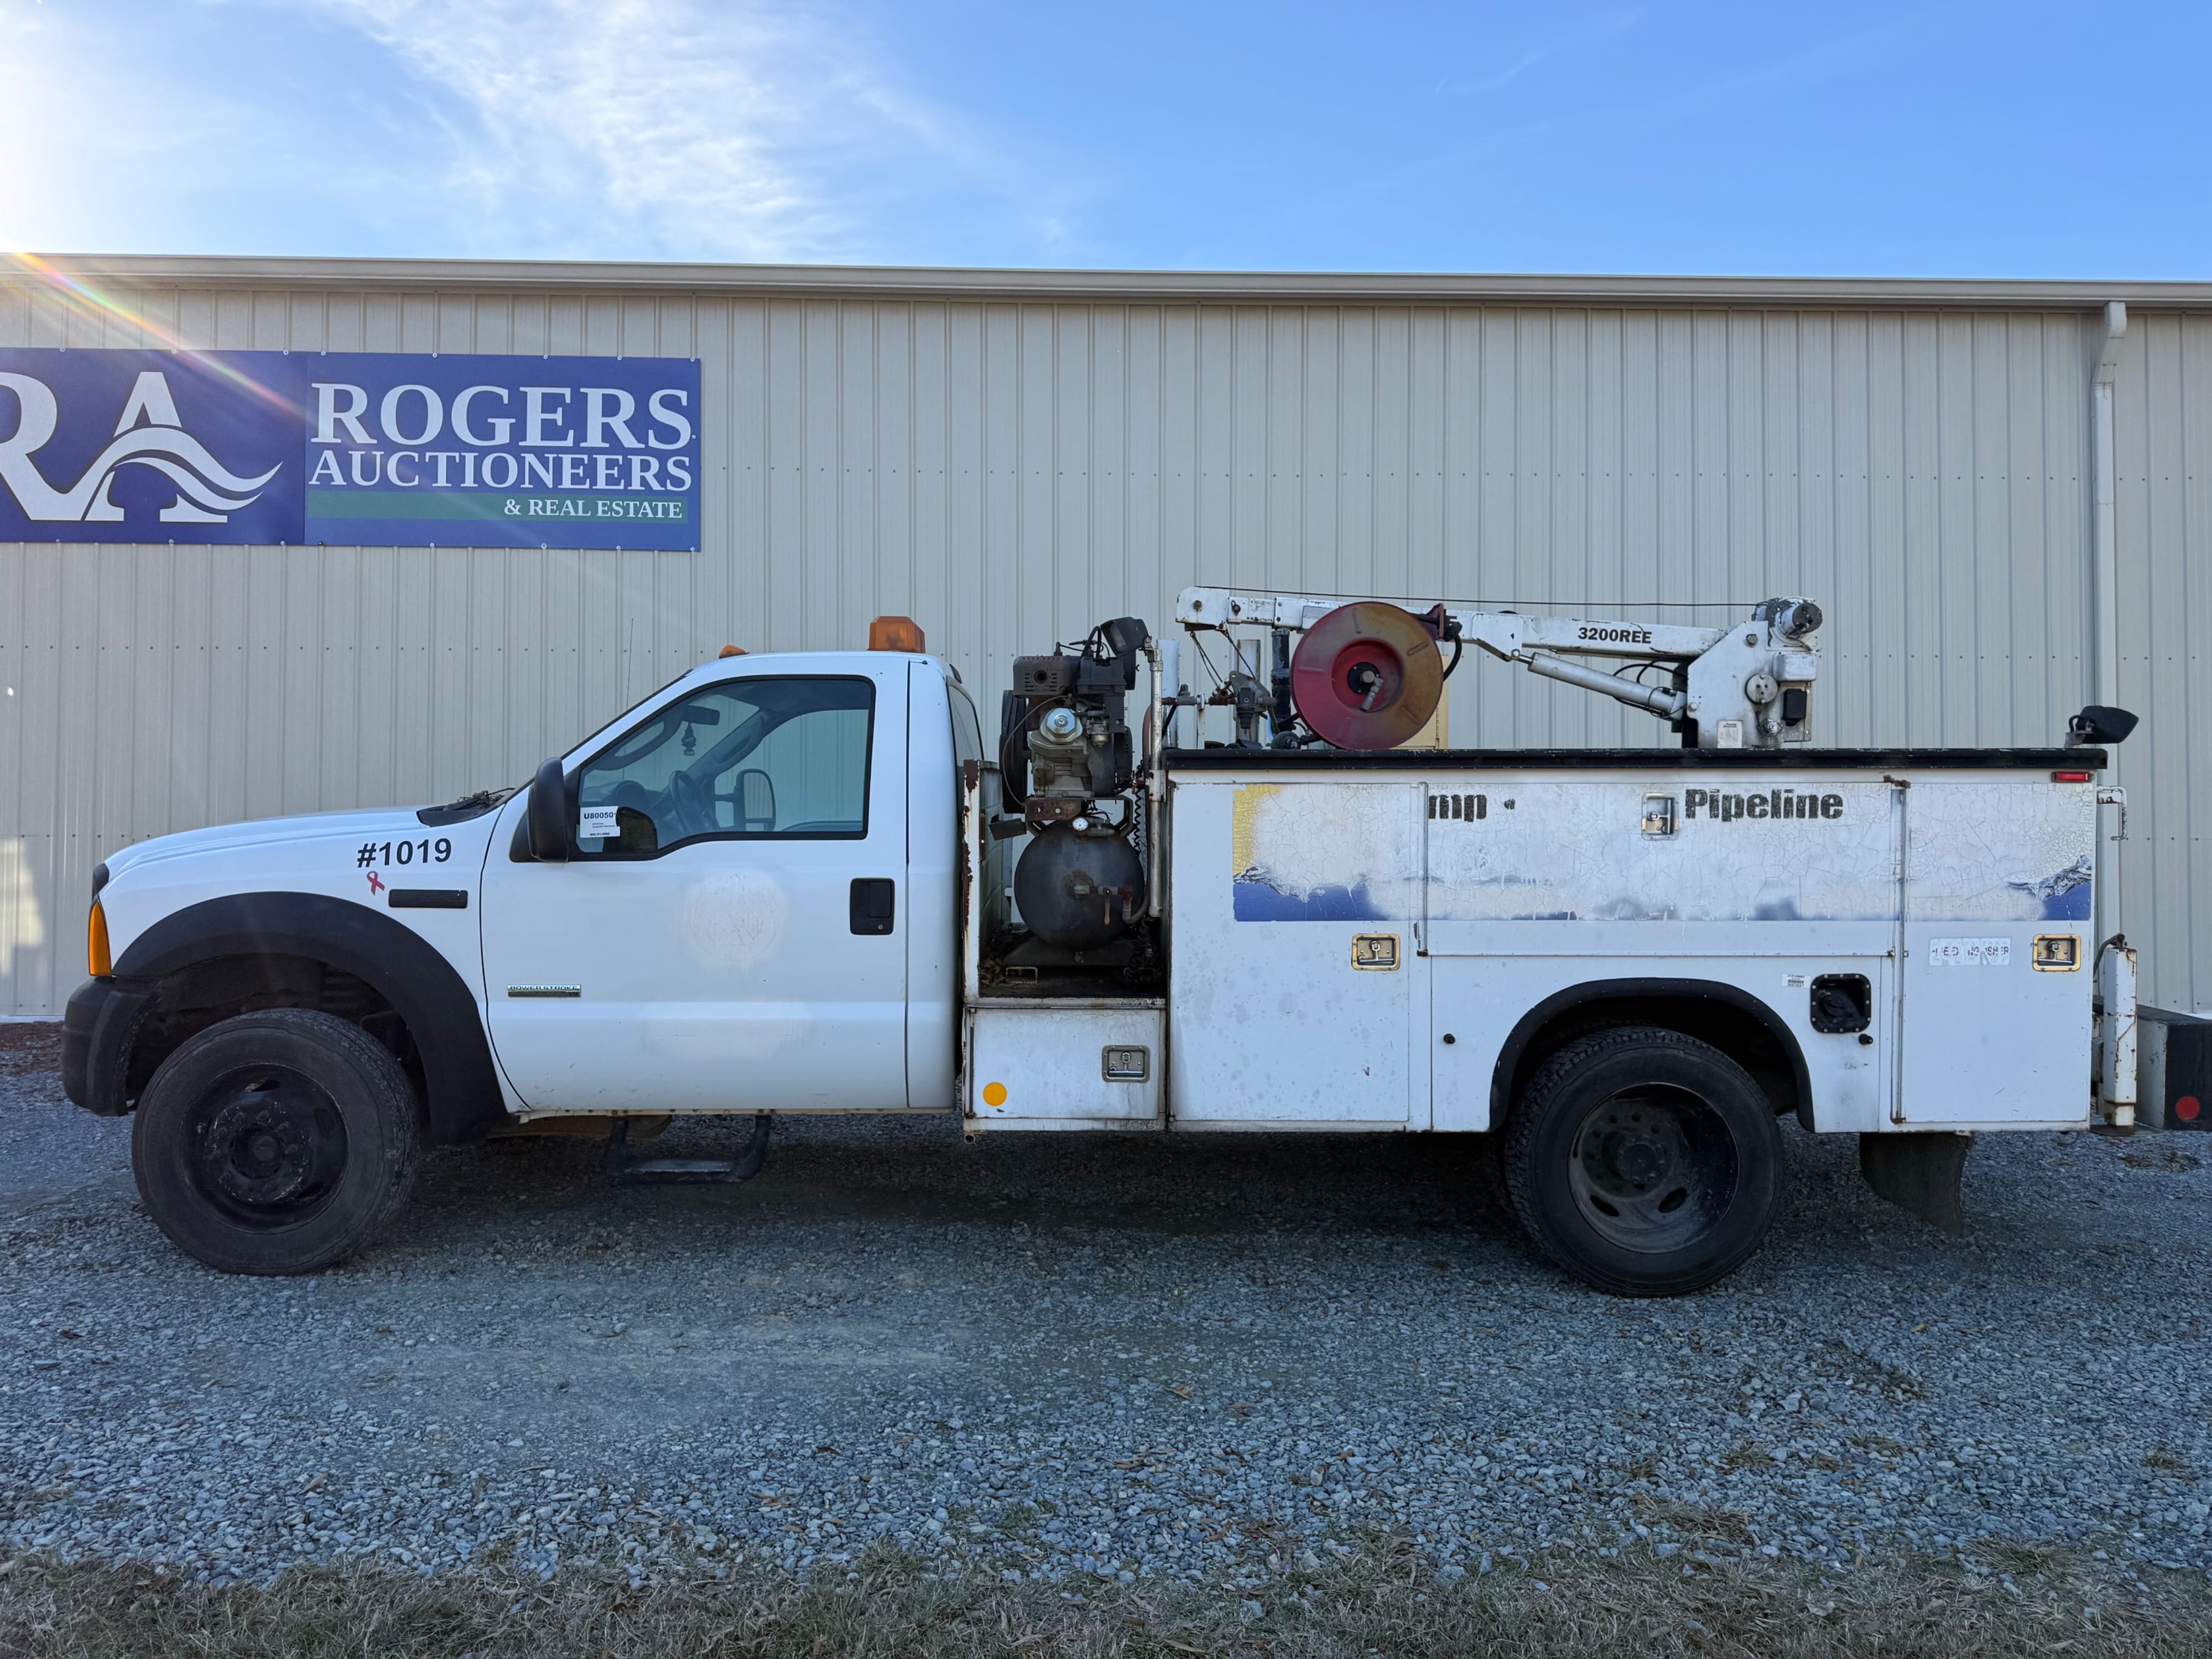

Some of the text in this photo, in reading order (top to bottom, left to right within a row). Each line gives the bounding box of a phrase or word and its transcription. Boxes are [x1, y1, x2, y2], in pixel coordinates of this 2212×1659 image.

[311, 383, 691, 450] ROGERS
[309, 450, 691, 491] AUCTIONEERS
[504, 499, 682, 518] & REAL ESTATE
[1578, 627, 1652, 644] 3200REE
[1685, 789, 1843, 822] Pipeline
[357, 838, 451, 868] #1019
